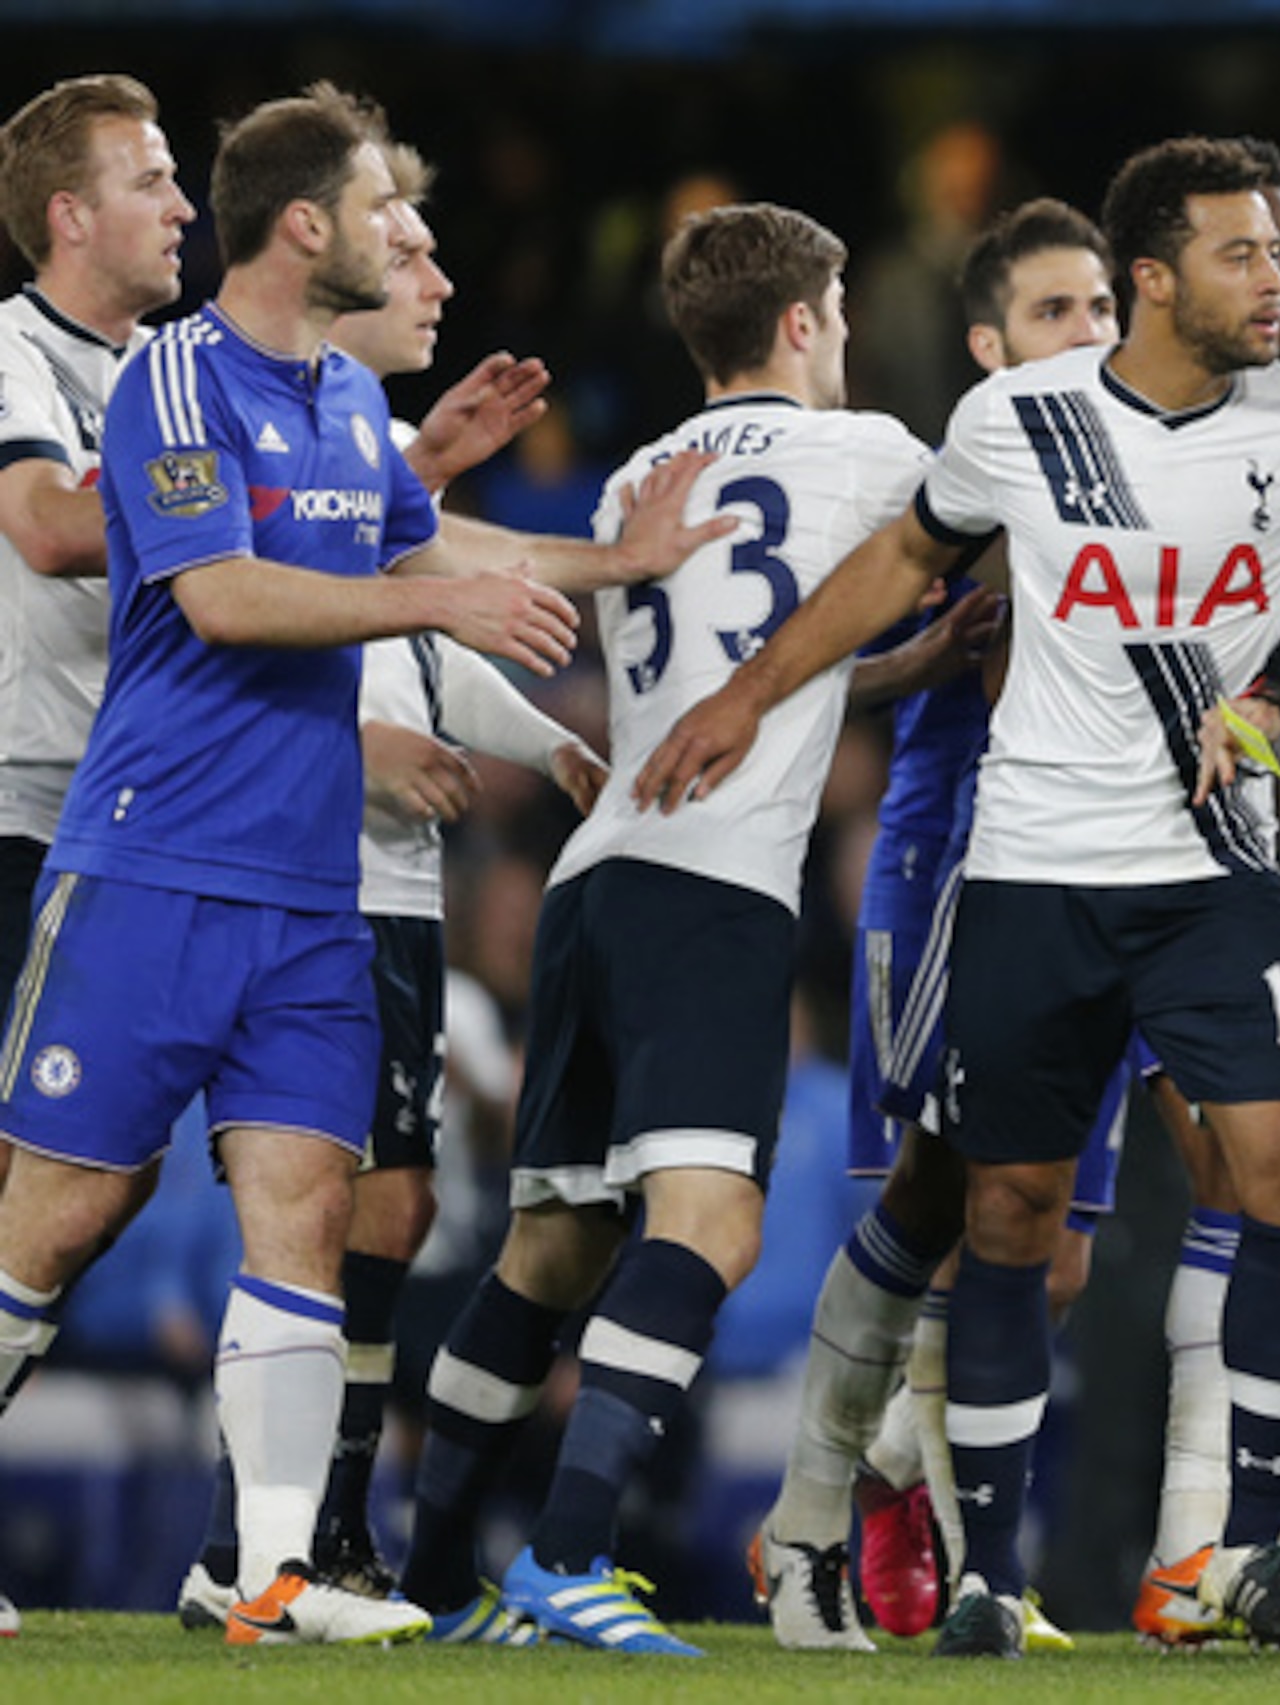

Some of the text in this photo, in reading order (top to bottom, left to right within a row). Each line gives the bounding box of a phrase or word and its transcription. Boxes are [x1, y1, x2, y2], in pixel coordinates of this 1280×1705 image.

[652, 422, 786, 467] VIES
[290, 488, 383, 522] YOKOHAM
[1052, 543, 1270, 630] AIA
